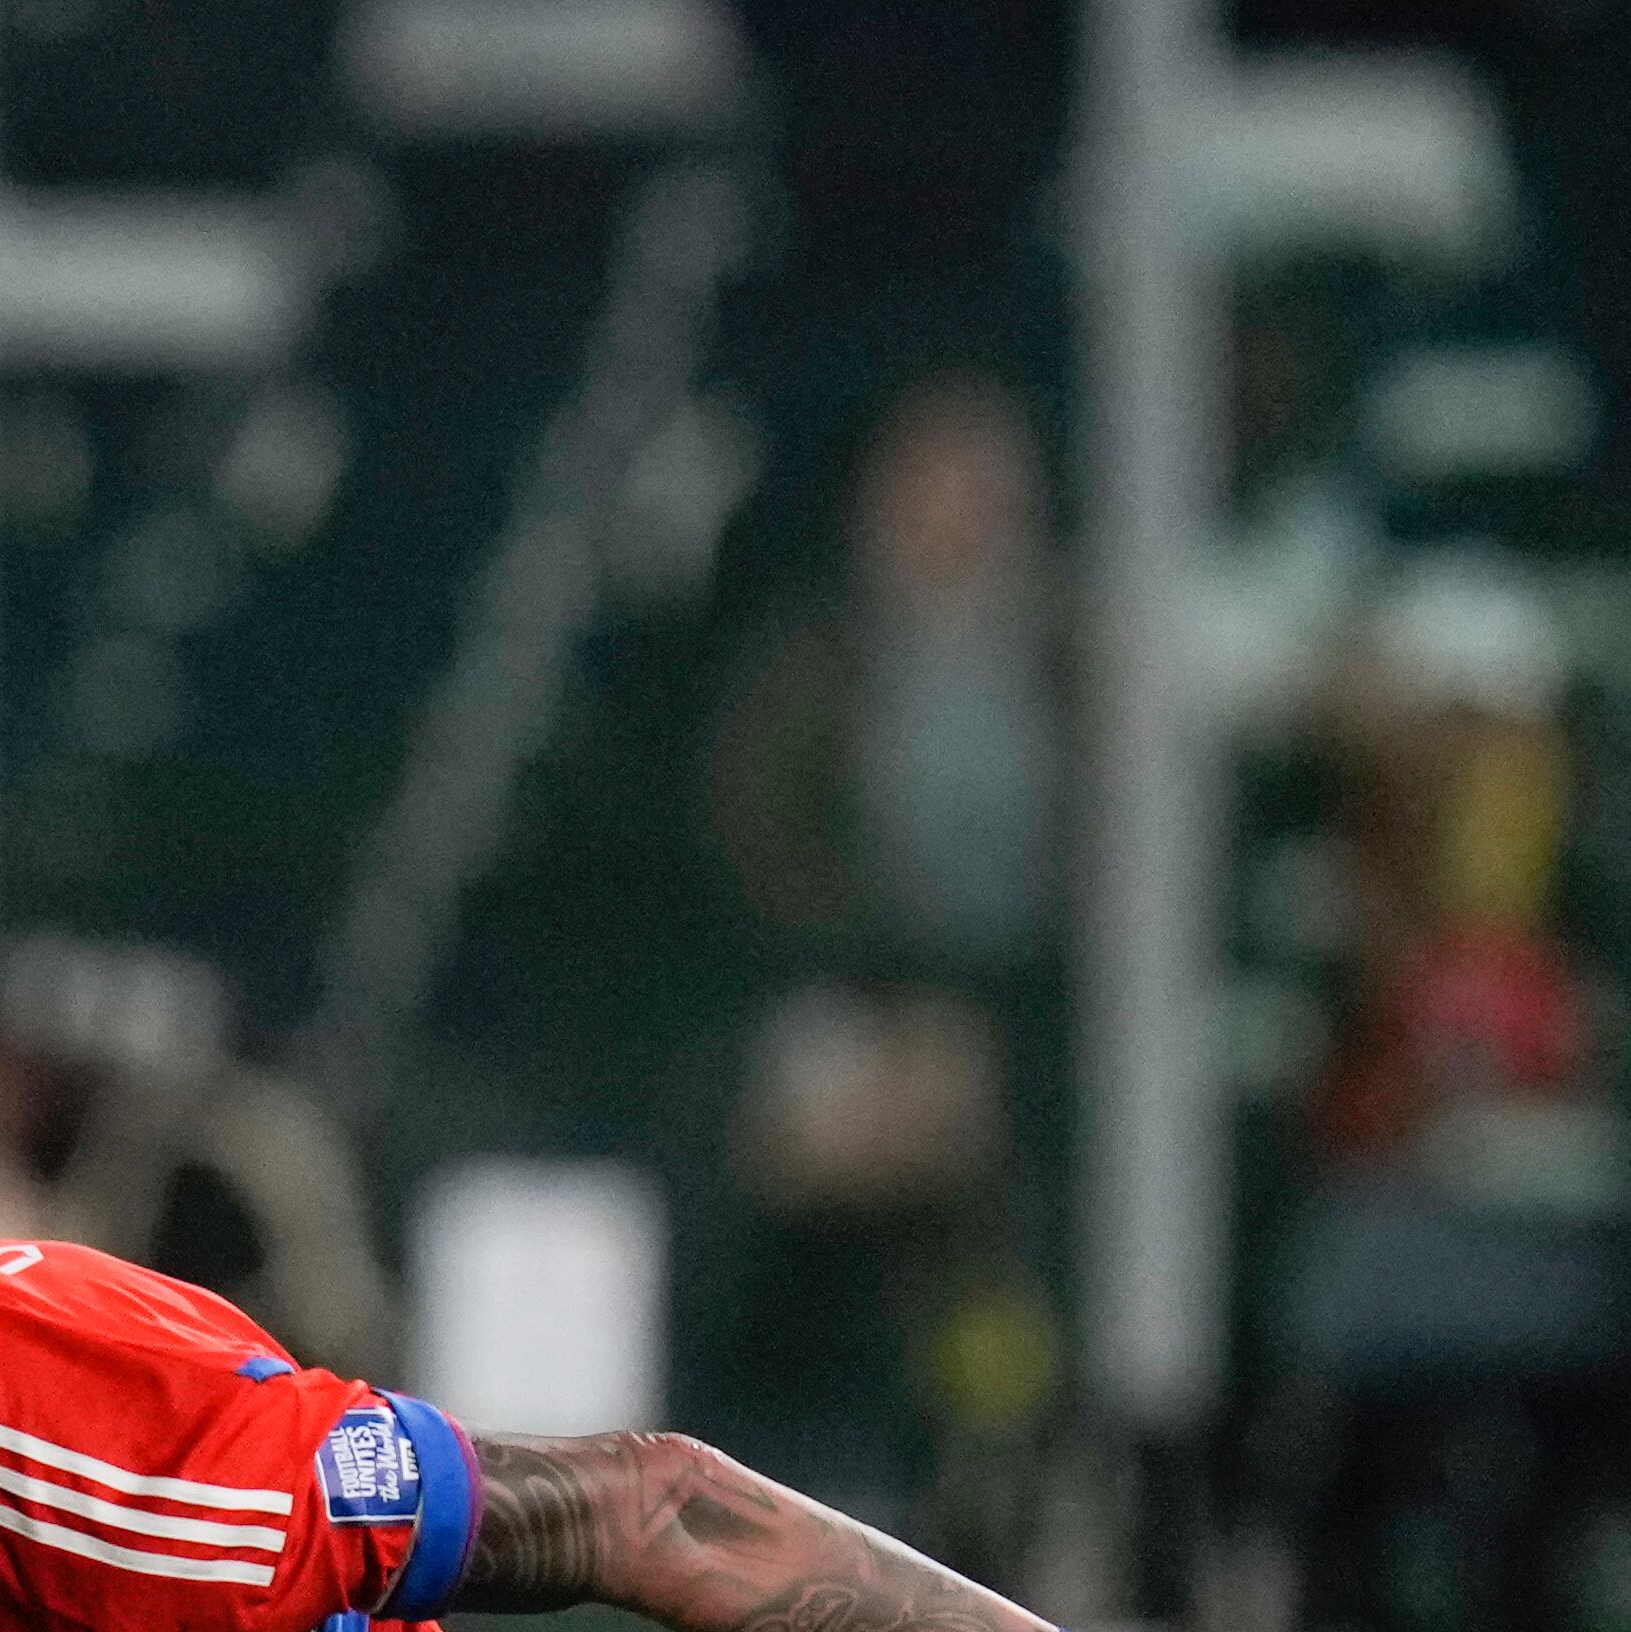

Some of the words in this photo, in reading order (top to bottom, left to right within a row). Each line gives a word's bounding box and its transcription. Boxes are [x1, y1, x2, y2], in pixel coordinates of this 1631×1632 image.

[328, 1426, 360, 1498] FOOTBALL
[346, 1425, 377, 1497] UNITES
[378, 1470, 400, 1503] the
